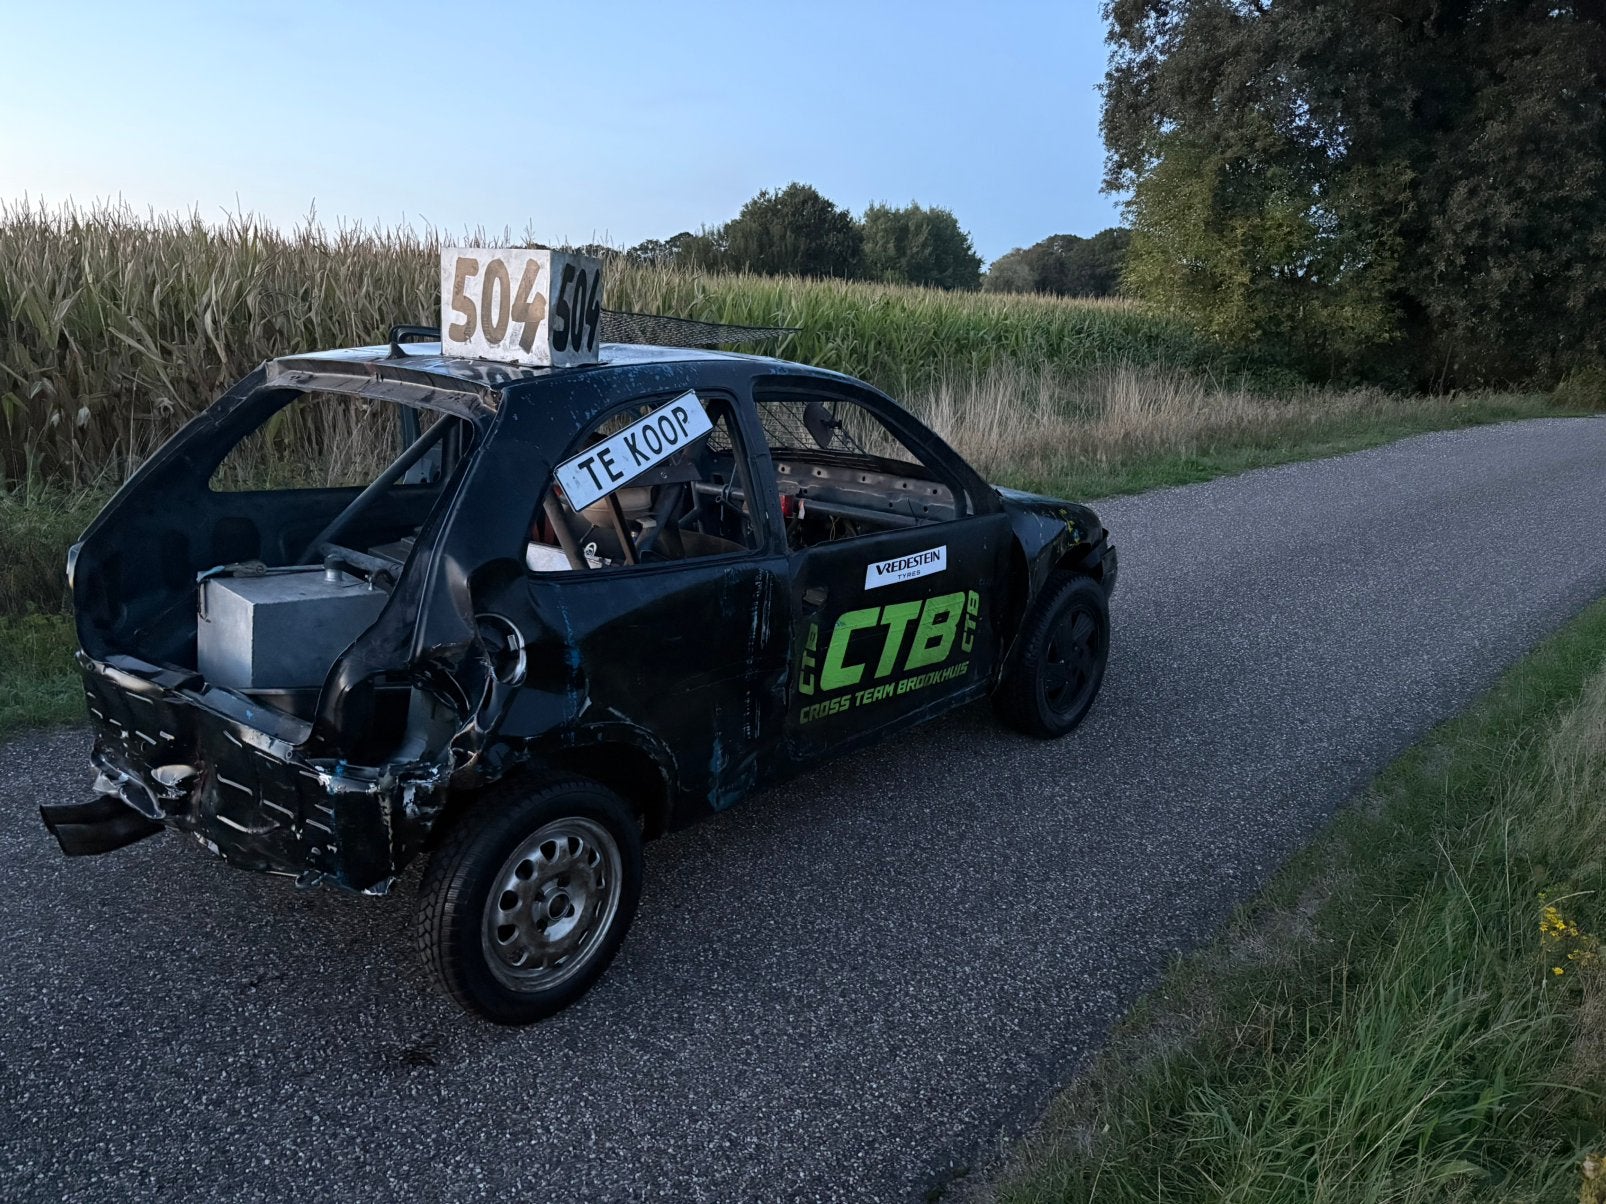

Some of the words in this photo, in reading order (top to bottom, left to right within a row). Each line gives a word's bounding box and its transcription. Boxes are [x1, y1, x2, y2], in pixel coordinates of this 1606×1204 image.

[448, 256, 547, 355] 504
[552, 262, 600, 353] 504
[577, 447, 625, 491] TE
[623, 406, 689, 467] KOOP
[875, 549, 941, 576] VREDESTEIN
[897, 569, 921, 580] TYRES
[820, 591, 966, 692] CTB
[961, 589, 980, 653] CTB
[798, 623, 819, 696] CTB
[799, 694, 852, 725] CROSS
[854, 681, 896, 707] TEAM
[896, 660, 970, 695] BROOKHUIS
